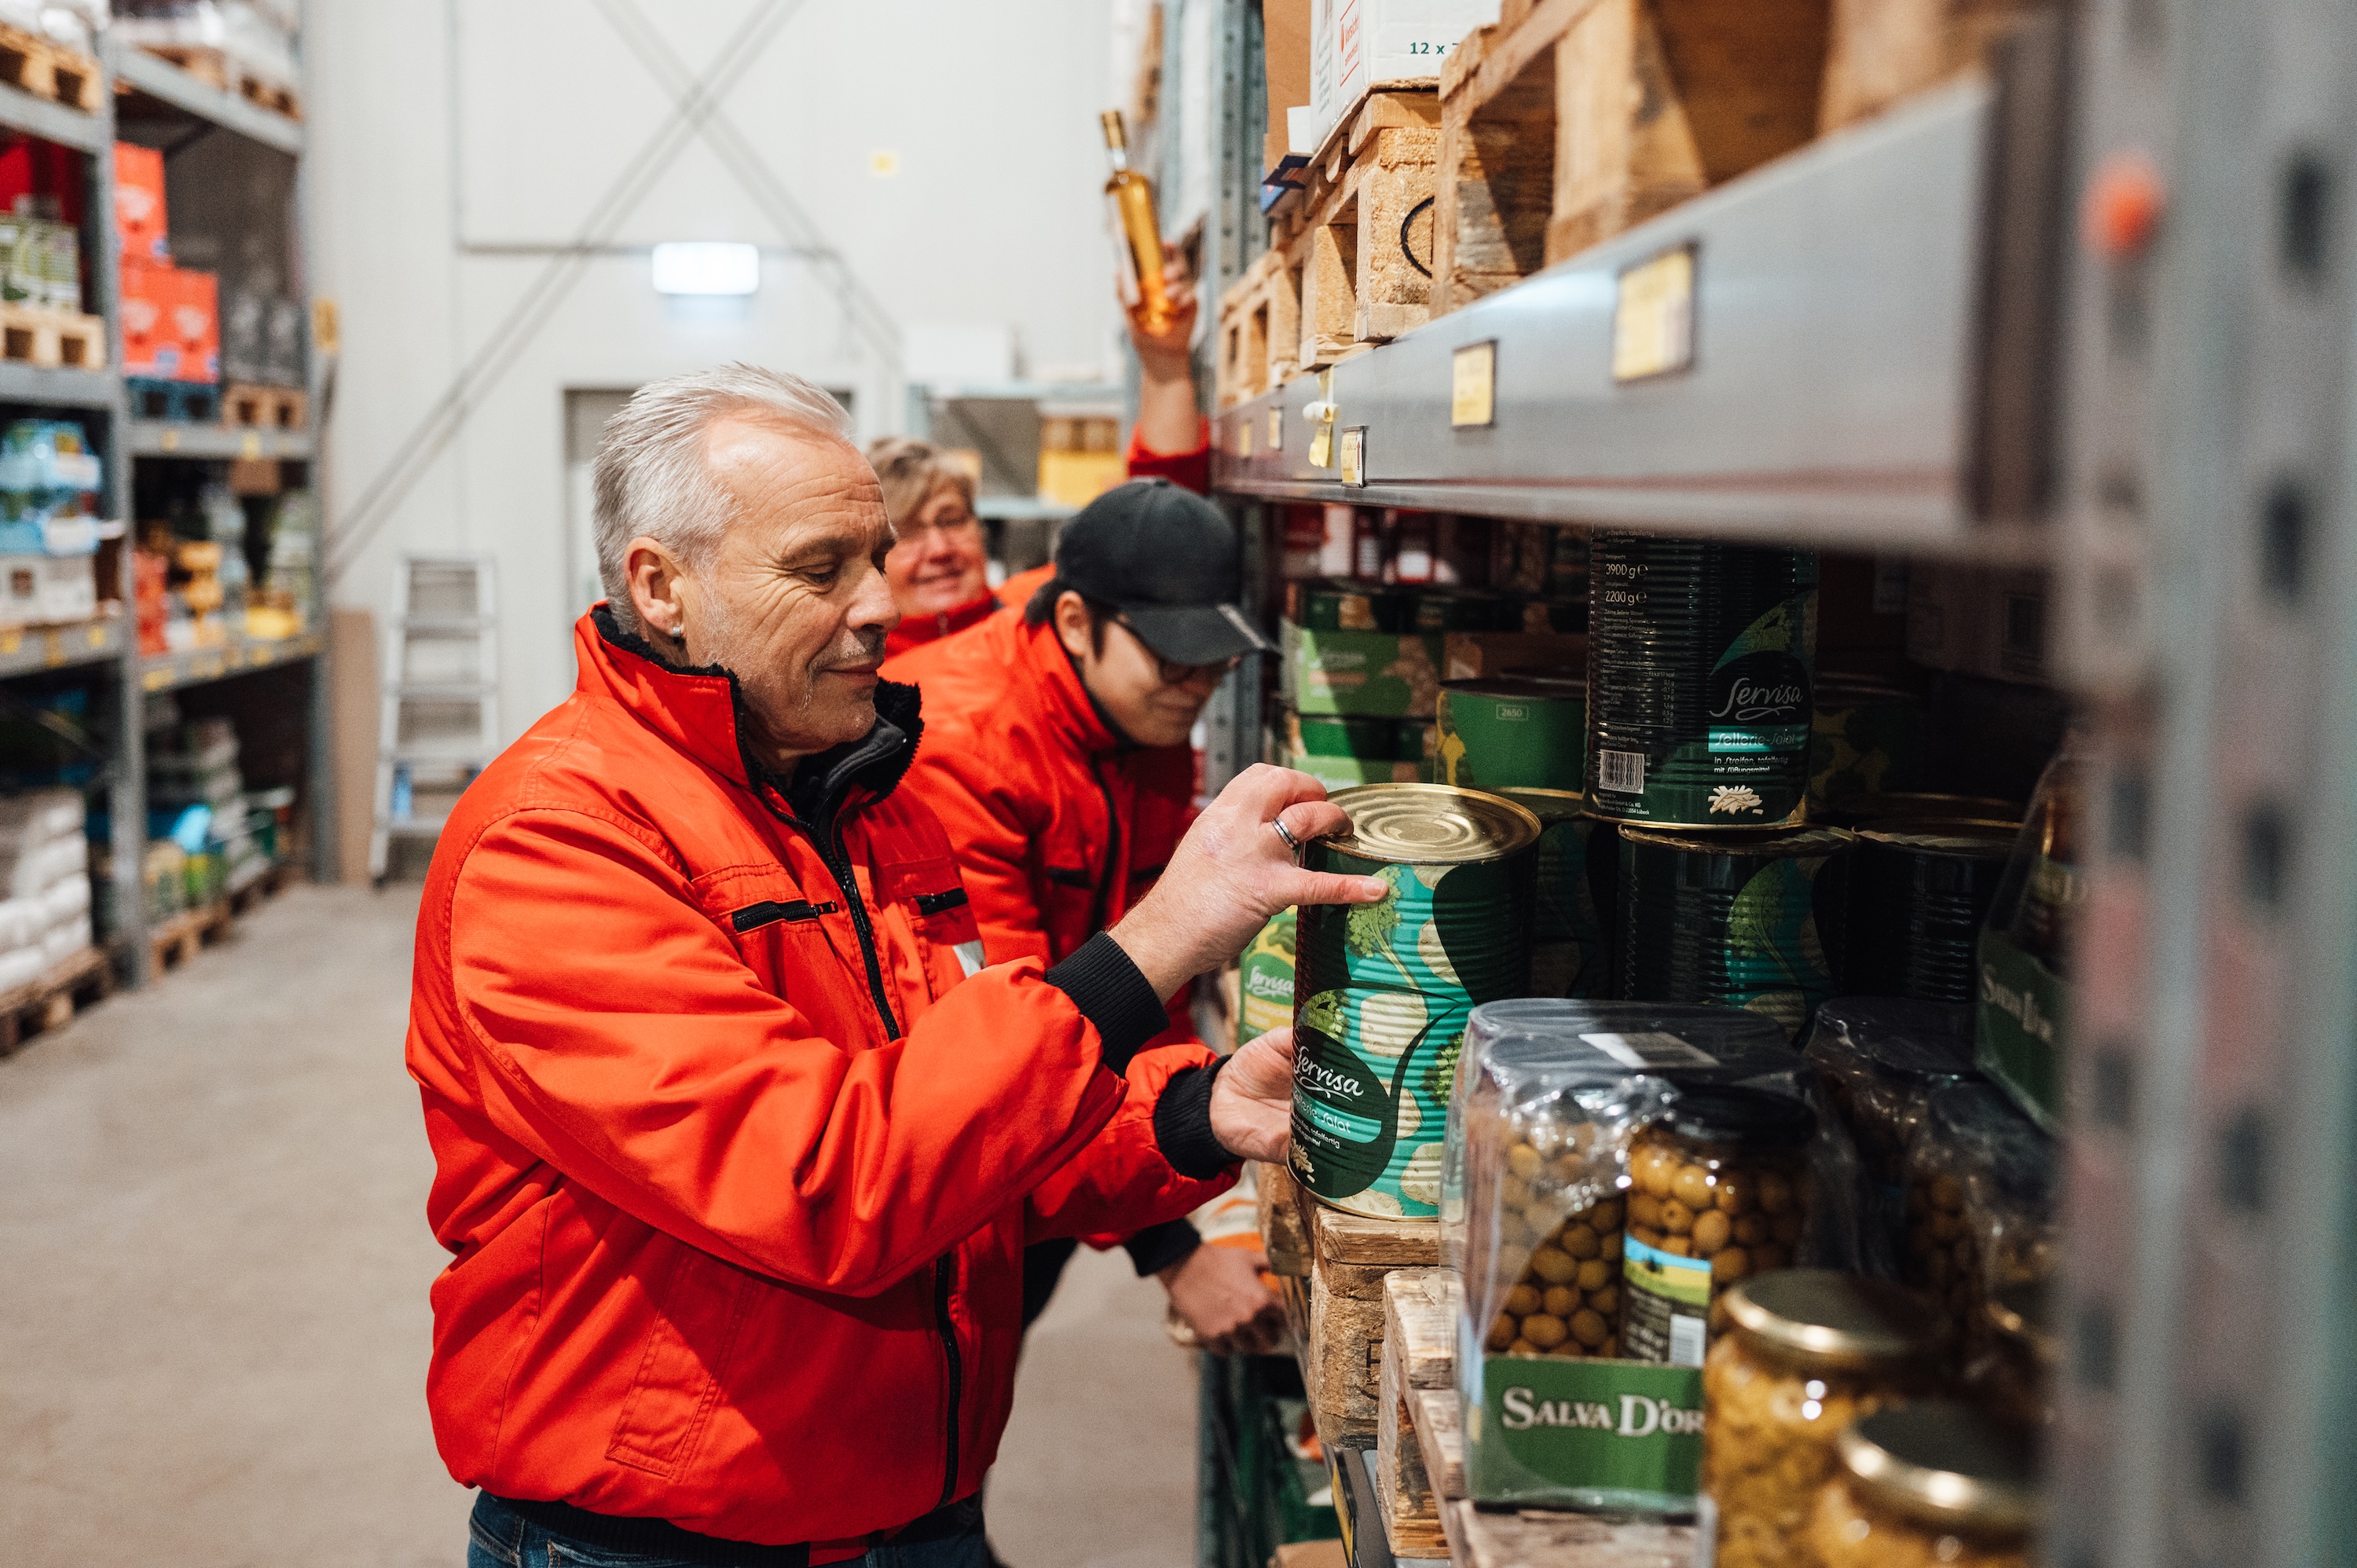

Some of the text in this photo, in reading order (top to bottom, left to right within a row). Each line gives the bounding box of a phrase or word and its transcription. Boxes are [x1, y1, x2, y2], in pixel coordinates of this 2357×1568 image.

[1410, 42, 1446, 55] 12 x
[1605, 563, 1628, 575] 3900
[1604, 590, 1626, 603] 2200
[1709, 677, 1804, 721] Servisa
[1294, 1045, 1364, 1098] Servisa
